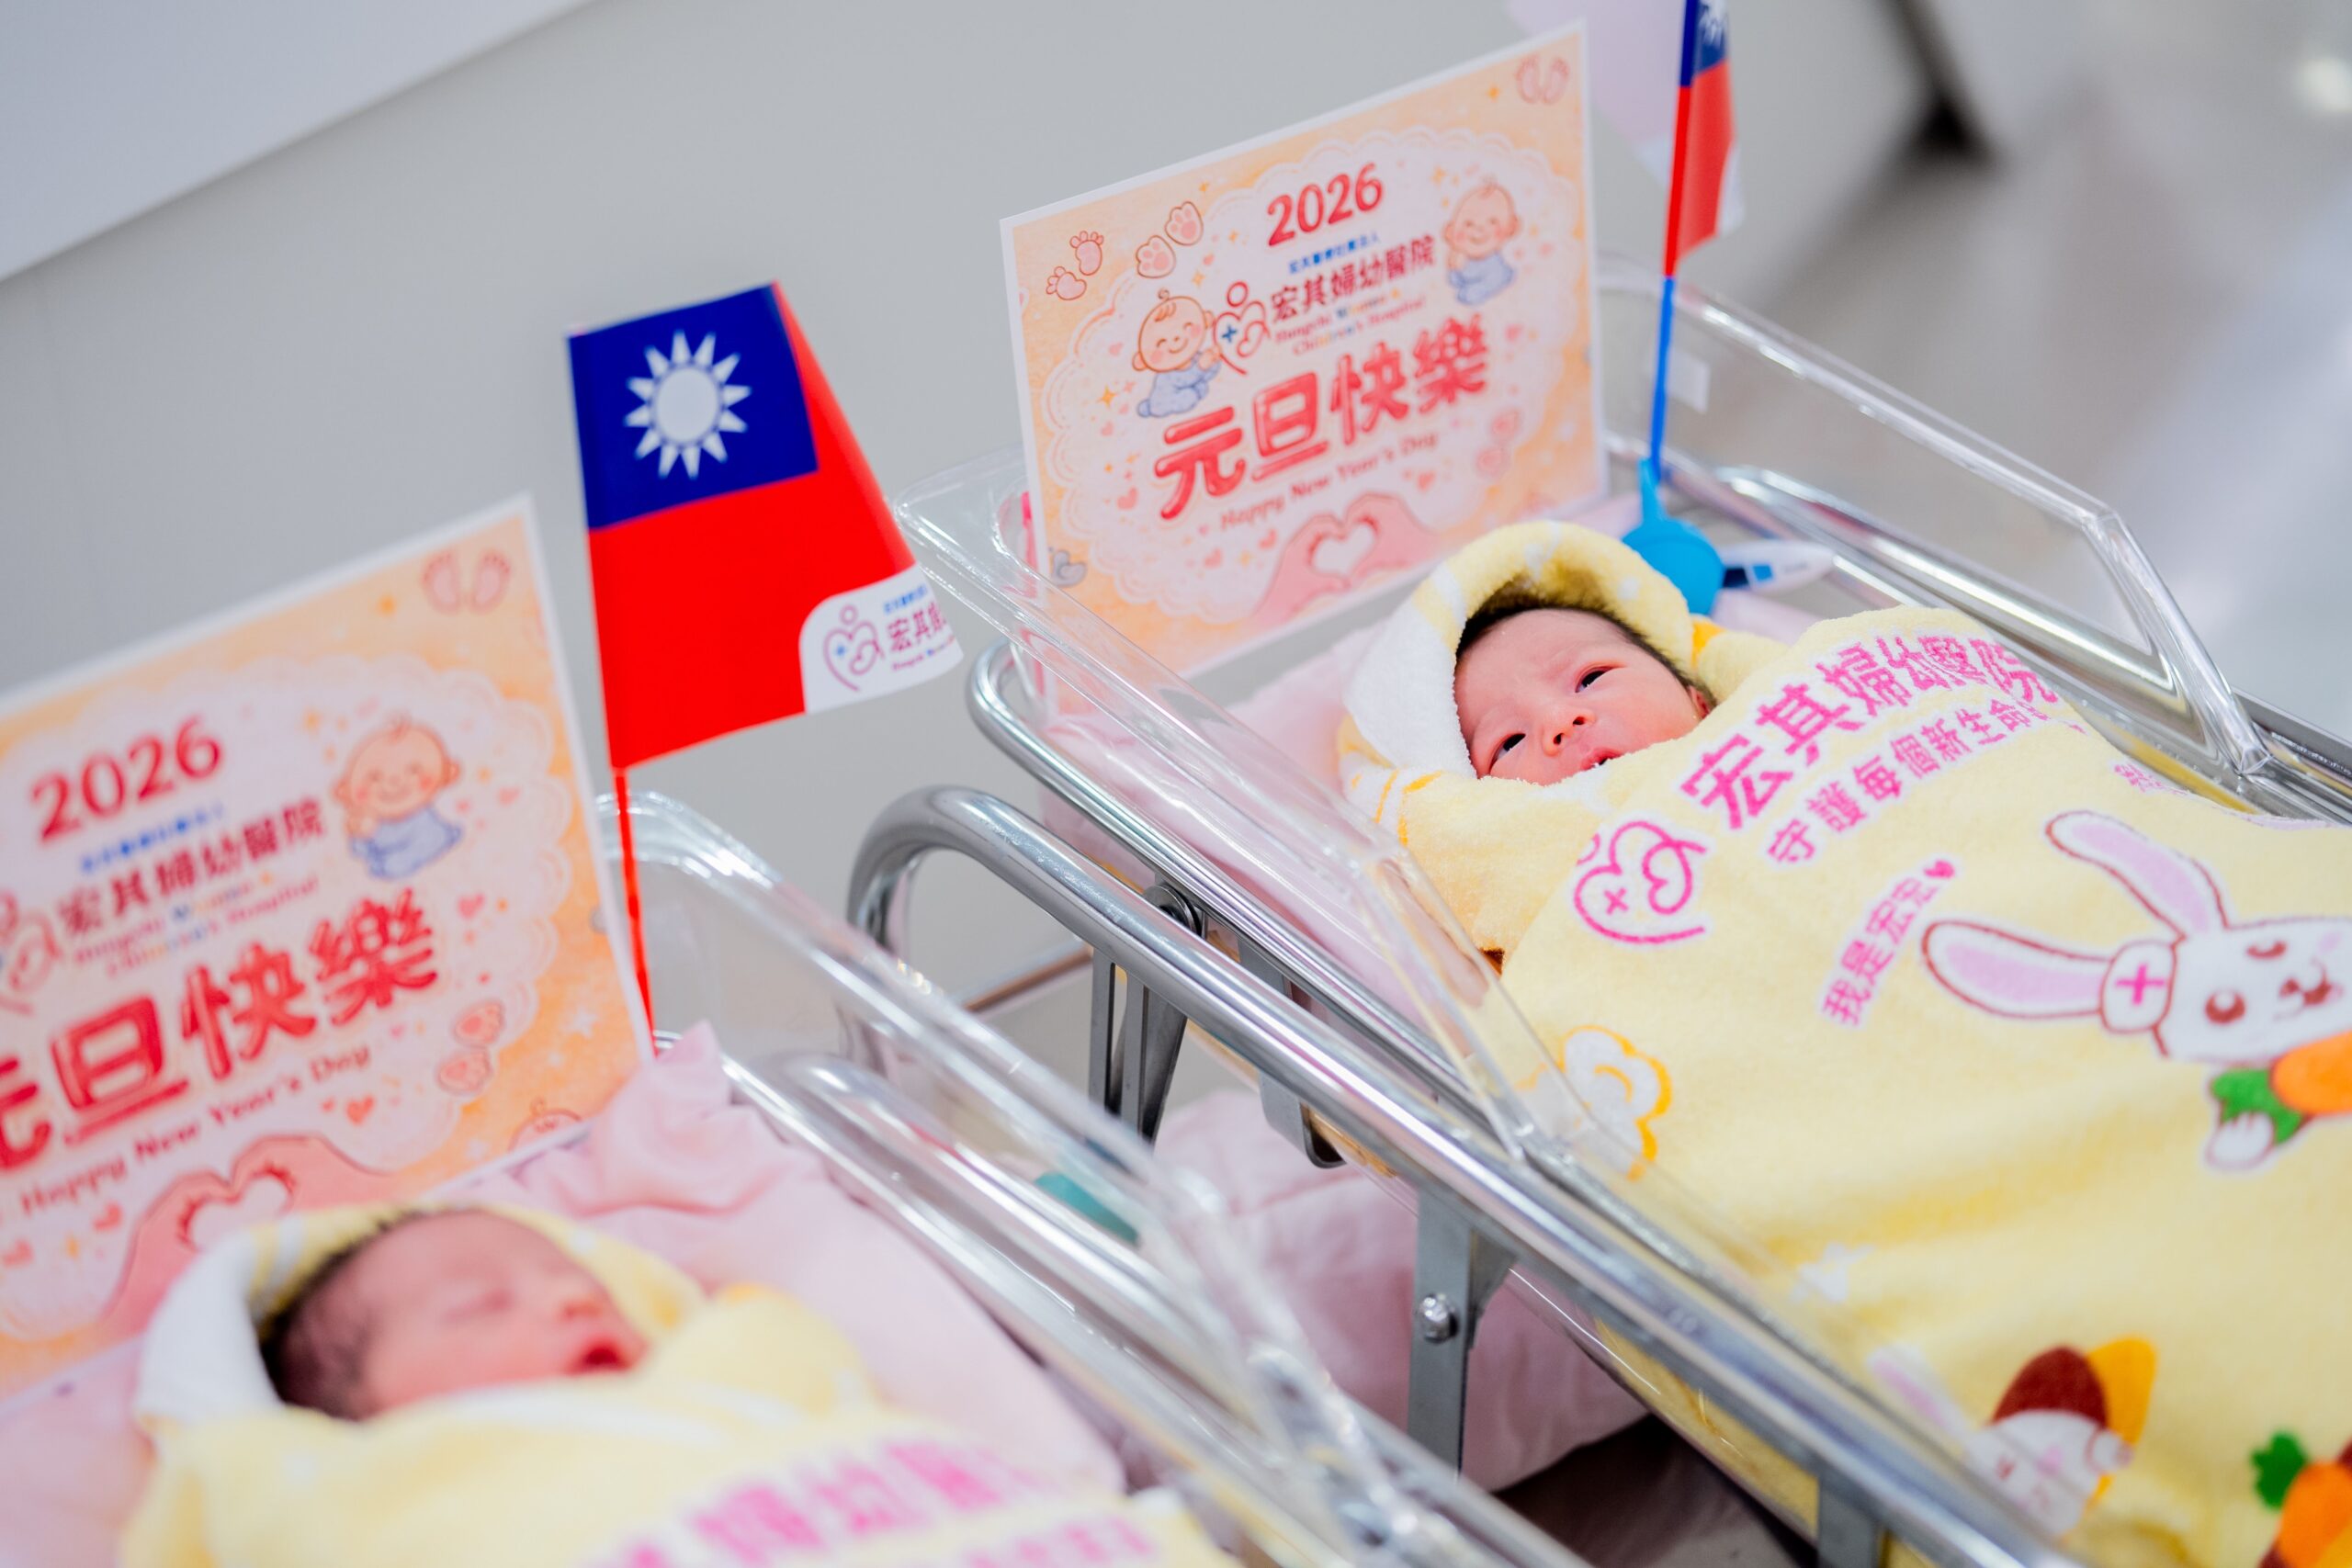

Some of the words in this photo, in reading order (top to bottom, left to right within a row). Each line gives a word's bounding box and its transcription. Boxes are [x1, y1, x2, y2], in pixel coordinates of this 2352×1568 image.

[1267, 162, 1384, 247] 2026
[1271, 233, 1435, 323] 宏其婦幼醫院
[1154, 312, 1488, 521] 元旦快樂
[1220, 497, 1285, 530] Happy
[1291, 477, 1329, 499] New
[1399, 433, 1438, 457] Day
[30, 715, 223, 845] 2026
[1679, 635, 2059, 829] 宏其婦幼醫院
[19, 1159, 127, 1218] Happy
[134, 1123, 198, 1160] New
[311, 1046, 370, 1085] Day
